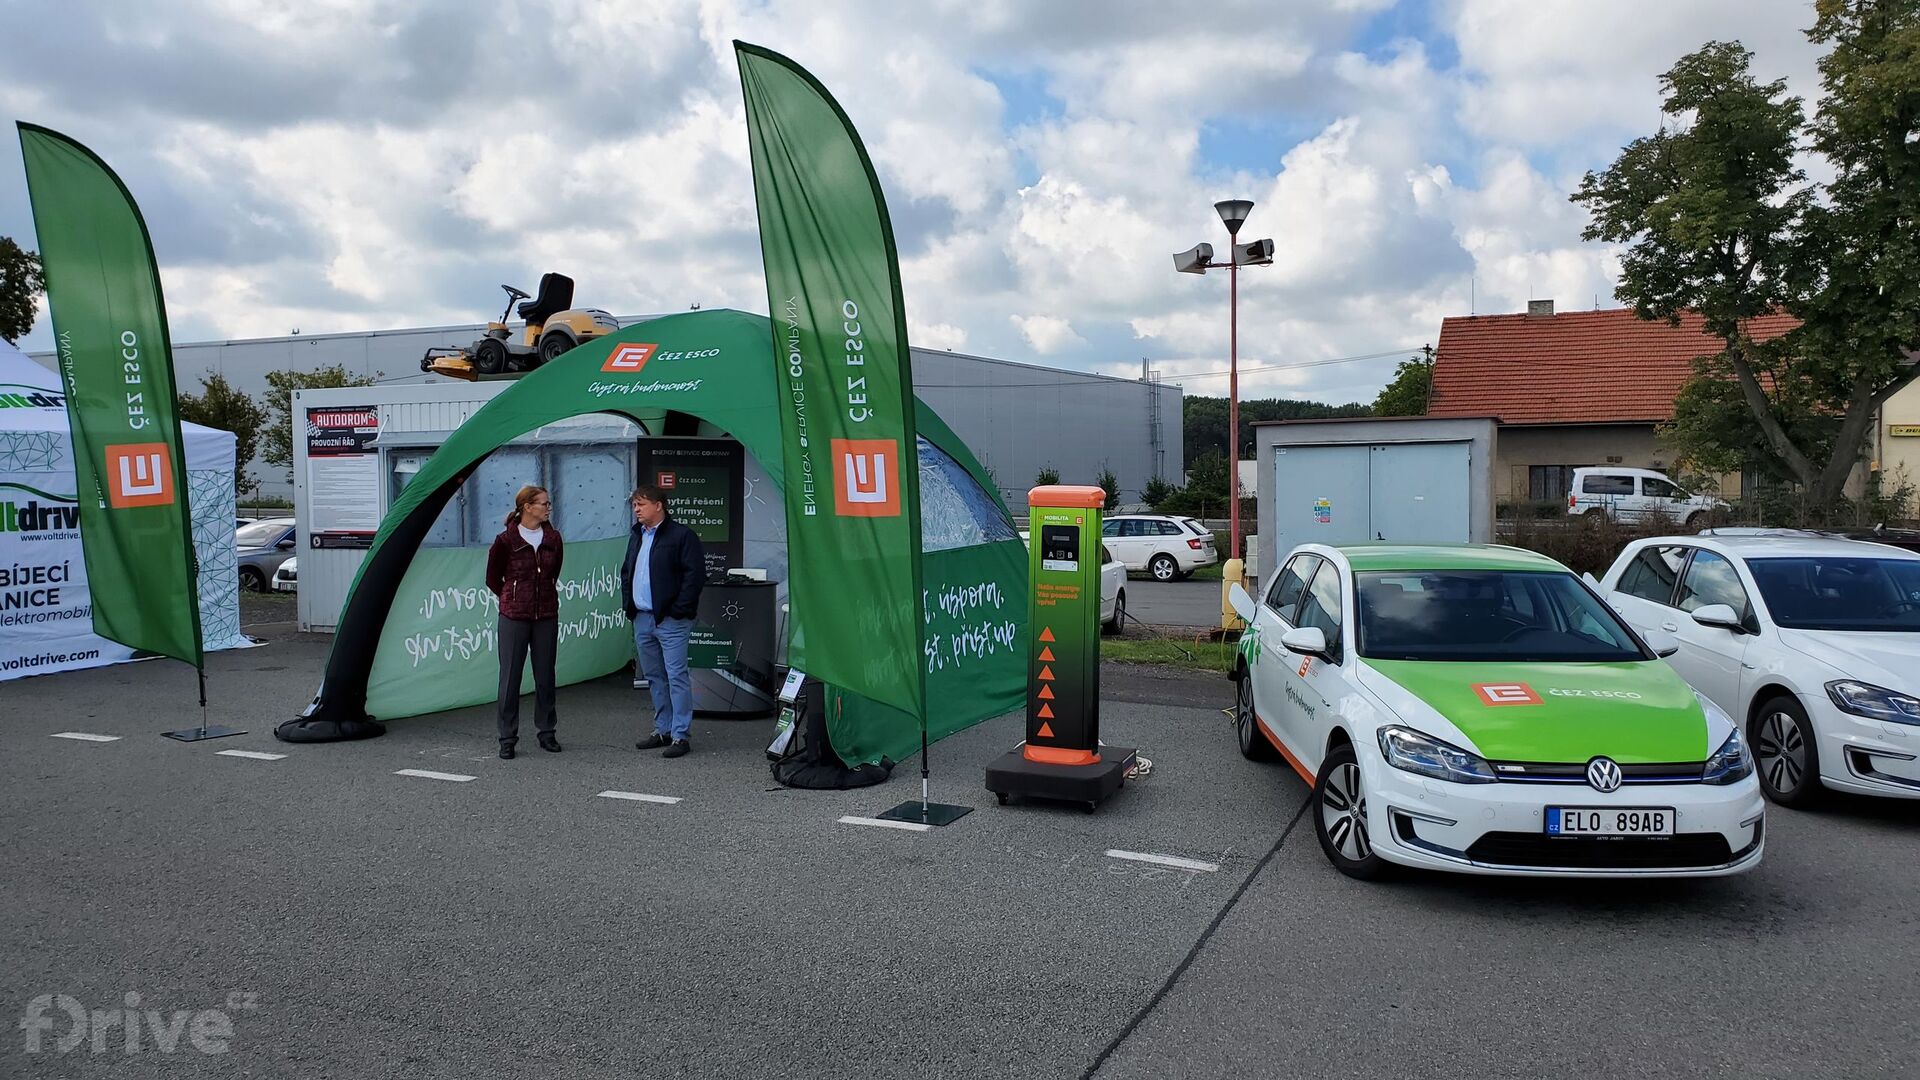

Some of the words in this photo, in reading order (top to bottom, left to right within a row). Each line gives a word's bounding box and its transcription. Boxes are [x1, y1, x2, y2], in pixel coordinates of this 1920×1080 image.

[657, 349, 682, 361] ČEZ
[685, 348, 720, 359] ESCO
[630, 378, 704, 394] budoucnost
[317, 413, 369, 427] AUTODROM
[311, 437, 341, 447] PROVOZNÍ
[693, 497, 724, 506] řešení
[20, 532, 81, 541] www.voltdrive.
[0, 560, 69, 587] BÍJECÍ
[0, 605, 92, 627] lektromobil
[0, 649, 100, 671] .voltdrive.com
[1549, 687, 1586, 697] ČEZ
[1592, 690, 1642, 699] ESCO
[1616, 812, 1664, 832] 89AB
